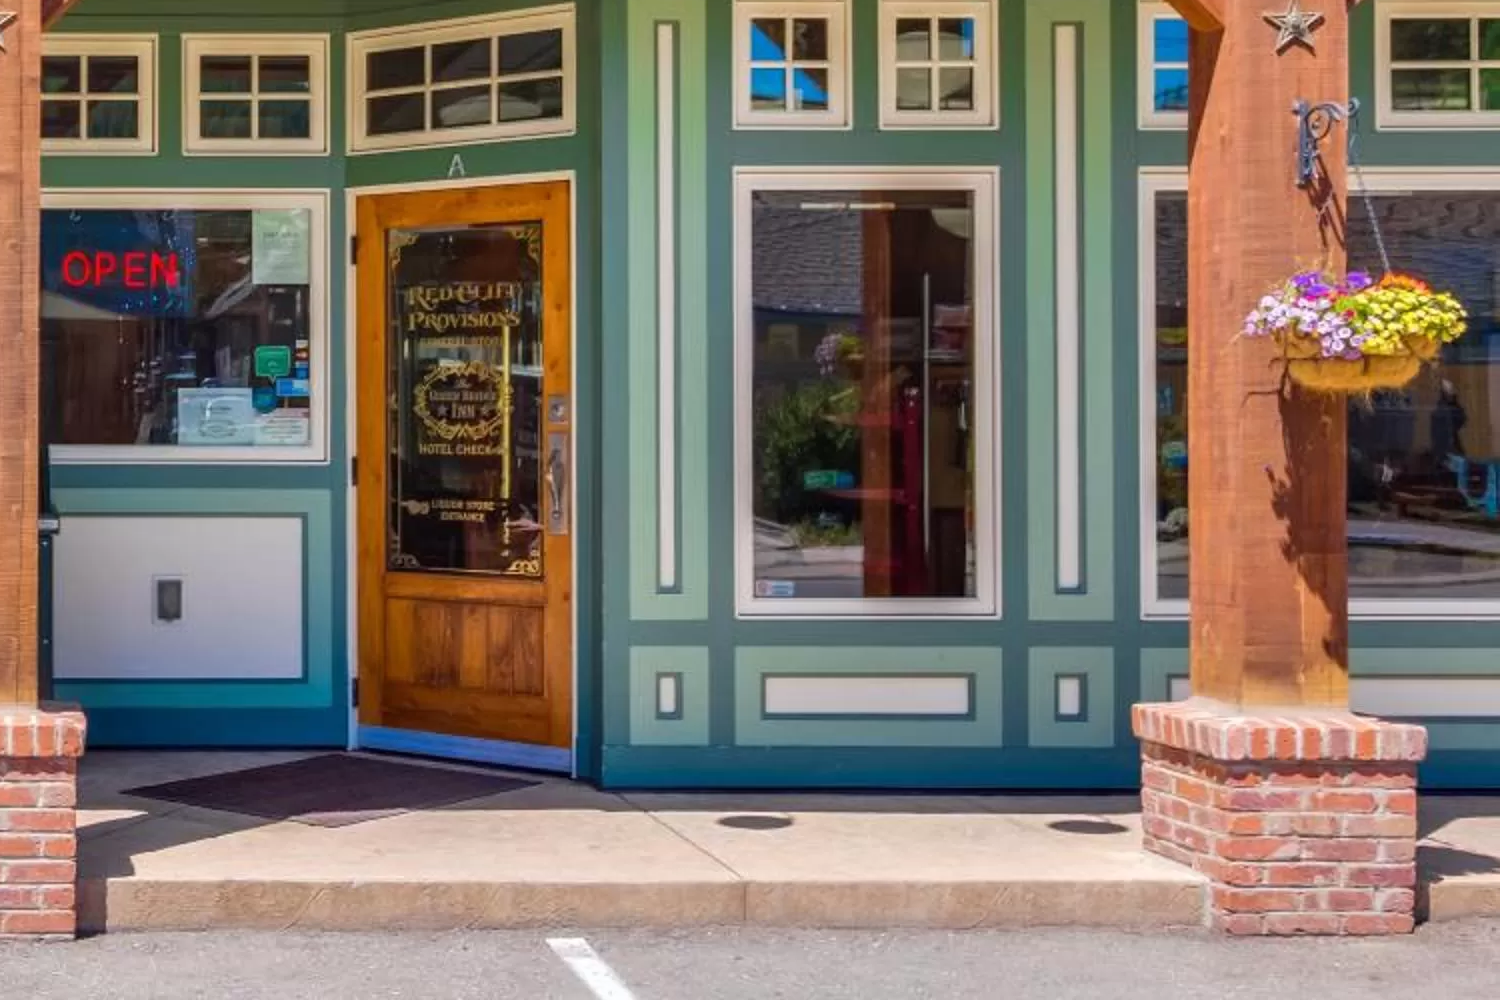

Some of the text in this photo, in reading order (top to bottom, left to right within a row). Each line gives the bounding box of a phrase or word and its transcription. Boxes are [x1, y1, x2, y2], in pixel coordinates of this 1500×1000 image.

[448, 153, 466, 178] A
[61, 251, 179, 289] OPEN
[408, 311, 521, 333] PROVISIONS
[419, 443, 452, 455] HOTEL
